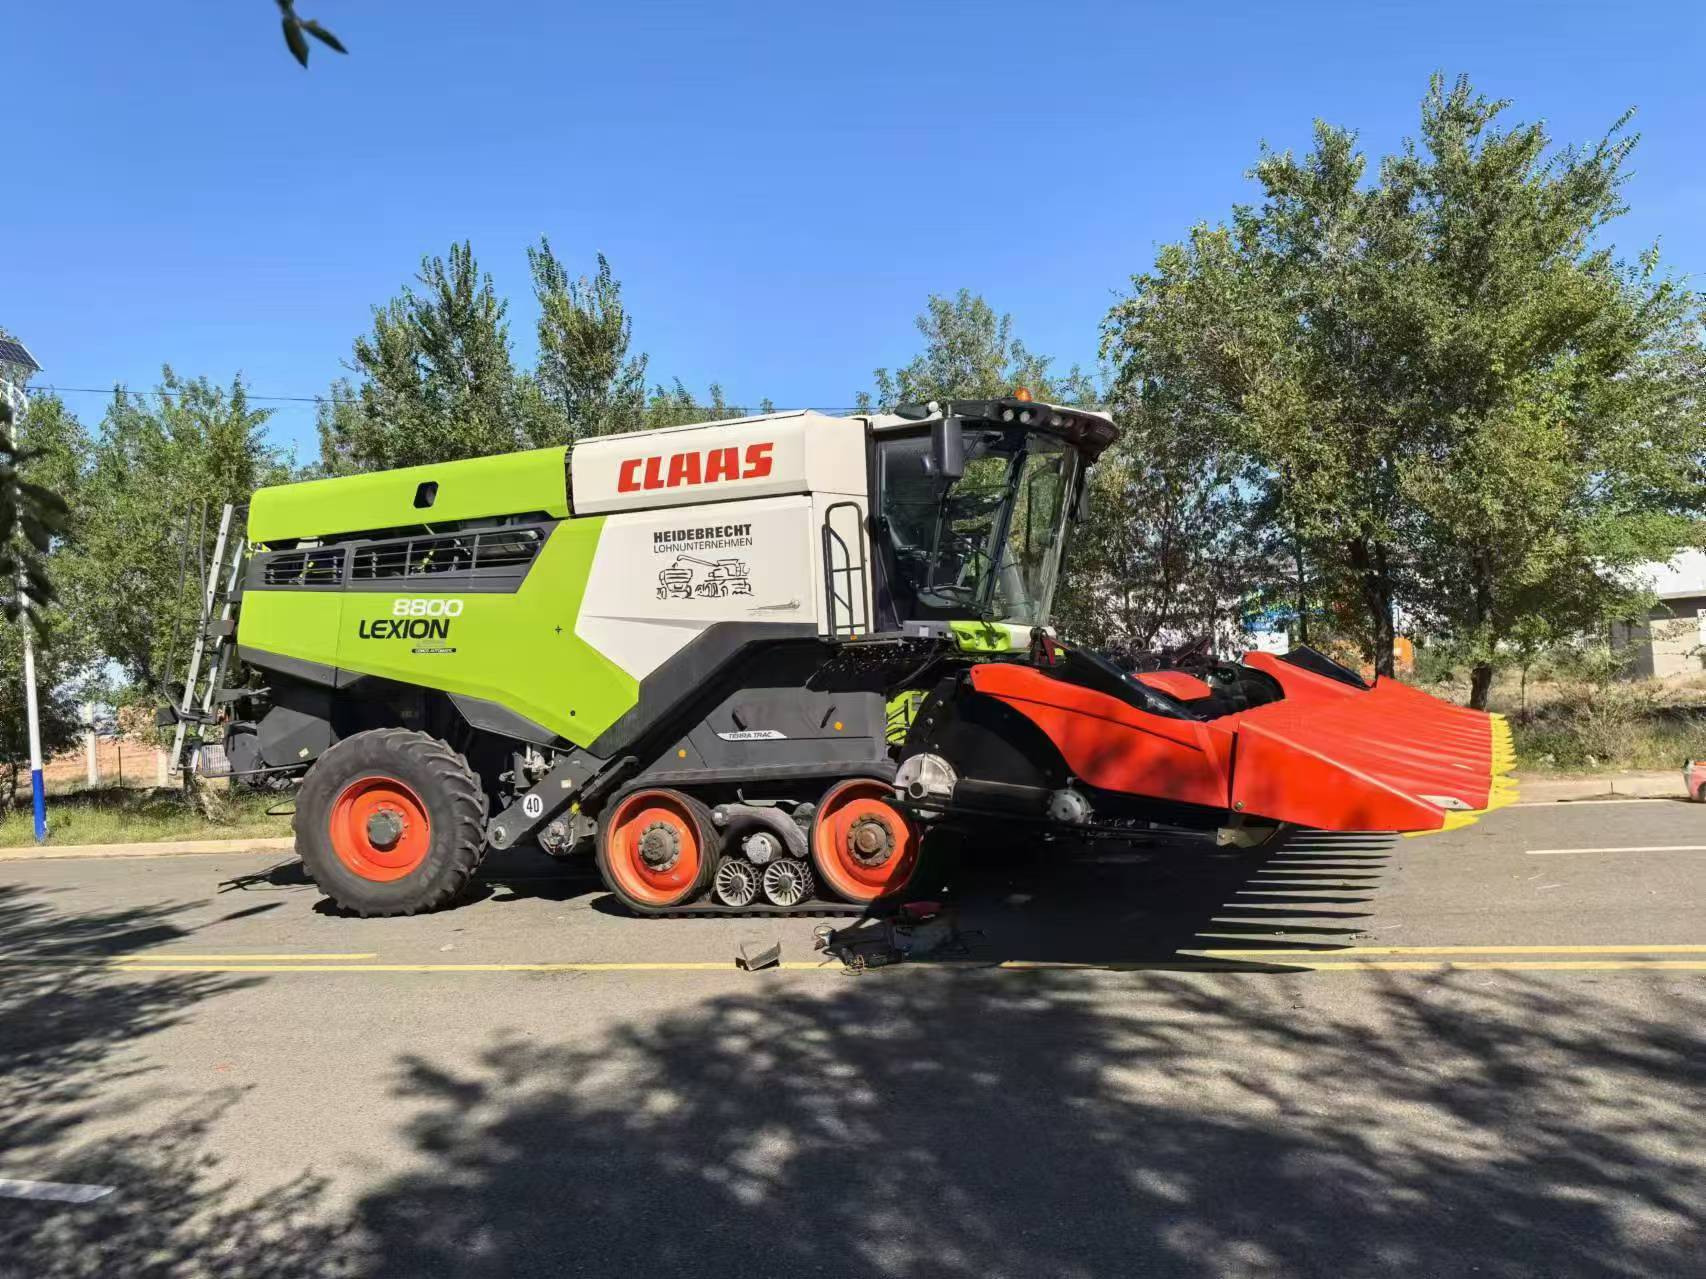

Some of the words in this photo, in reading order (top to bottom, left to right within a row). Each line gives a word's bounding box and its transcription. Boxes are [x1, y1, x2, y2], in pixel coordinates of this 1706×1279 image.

[617, 442, 774, 493] CLAAS
[653, 524, 752, 543] HEIDEBRECHT
[653, 537, 753, 554] LOHNUNTERNEHMEN
[393, 598, 464, 617] 8800
[359, 618, 450, 640] LEXION
[526, 797, 540, 813] 40
